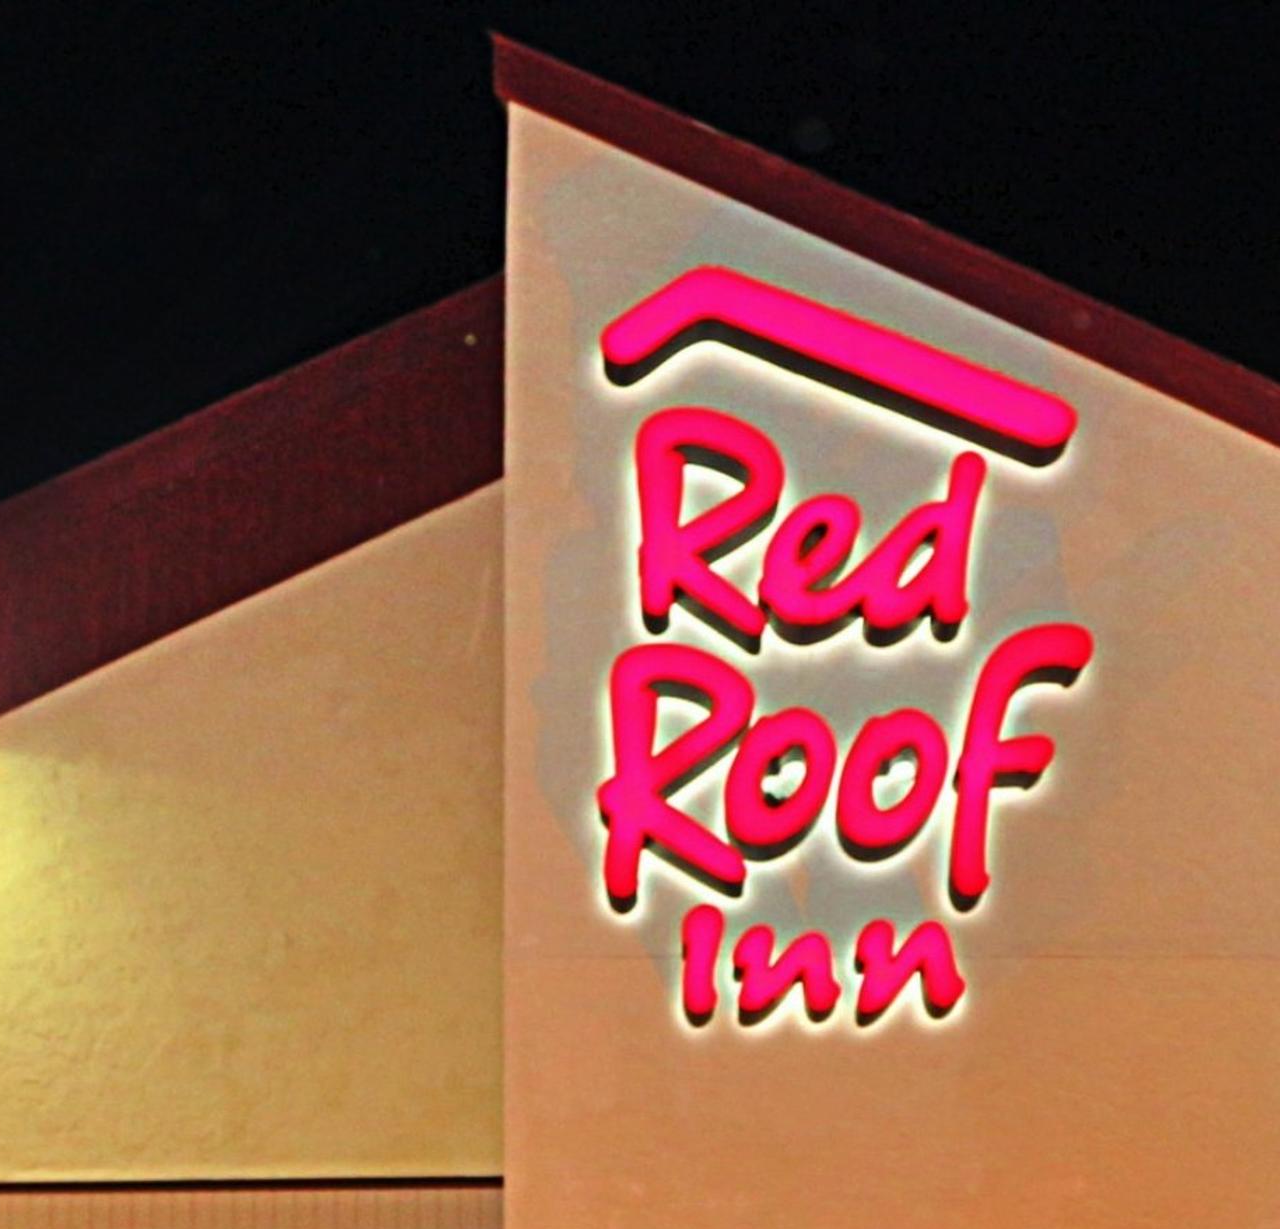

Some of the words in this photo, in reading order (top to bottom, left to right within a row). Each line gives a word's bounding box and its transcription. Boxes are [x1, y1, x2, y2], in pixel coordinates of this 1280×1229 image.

[635, 407, 987, 646] Red
[597, 622, 1094, 908] Roof
[682, 904, 966, 1022] Inn
